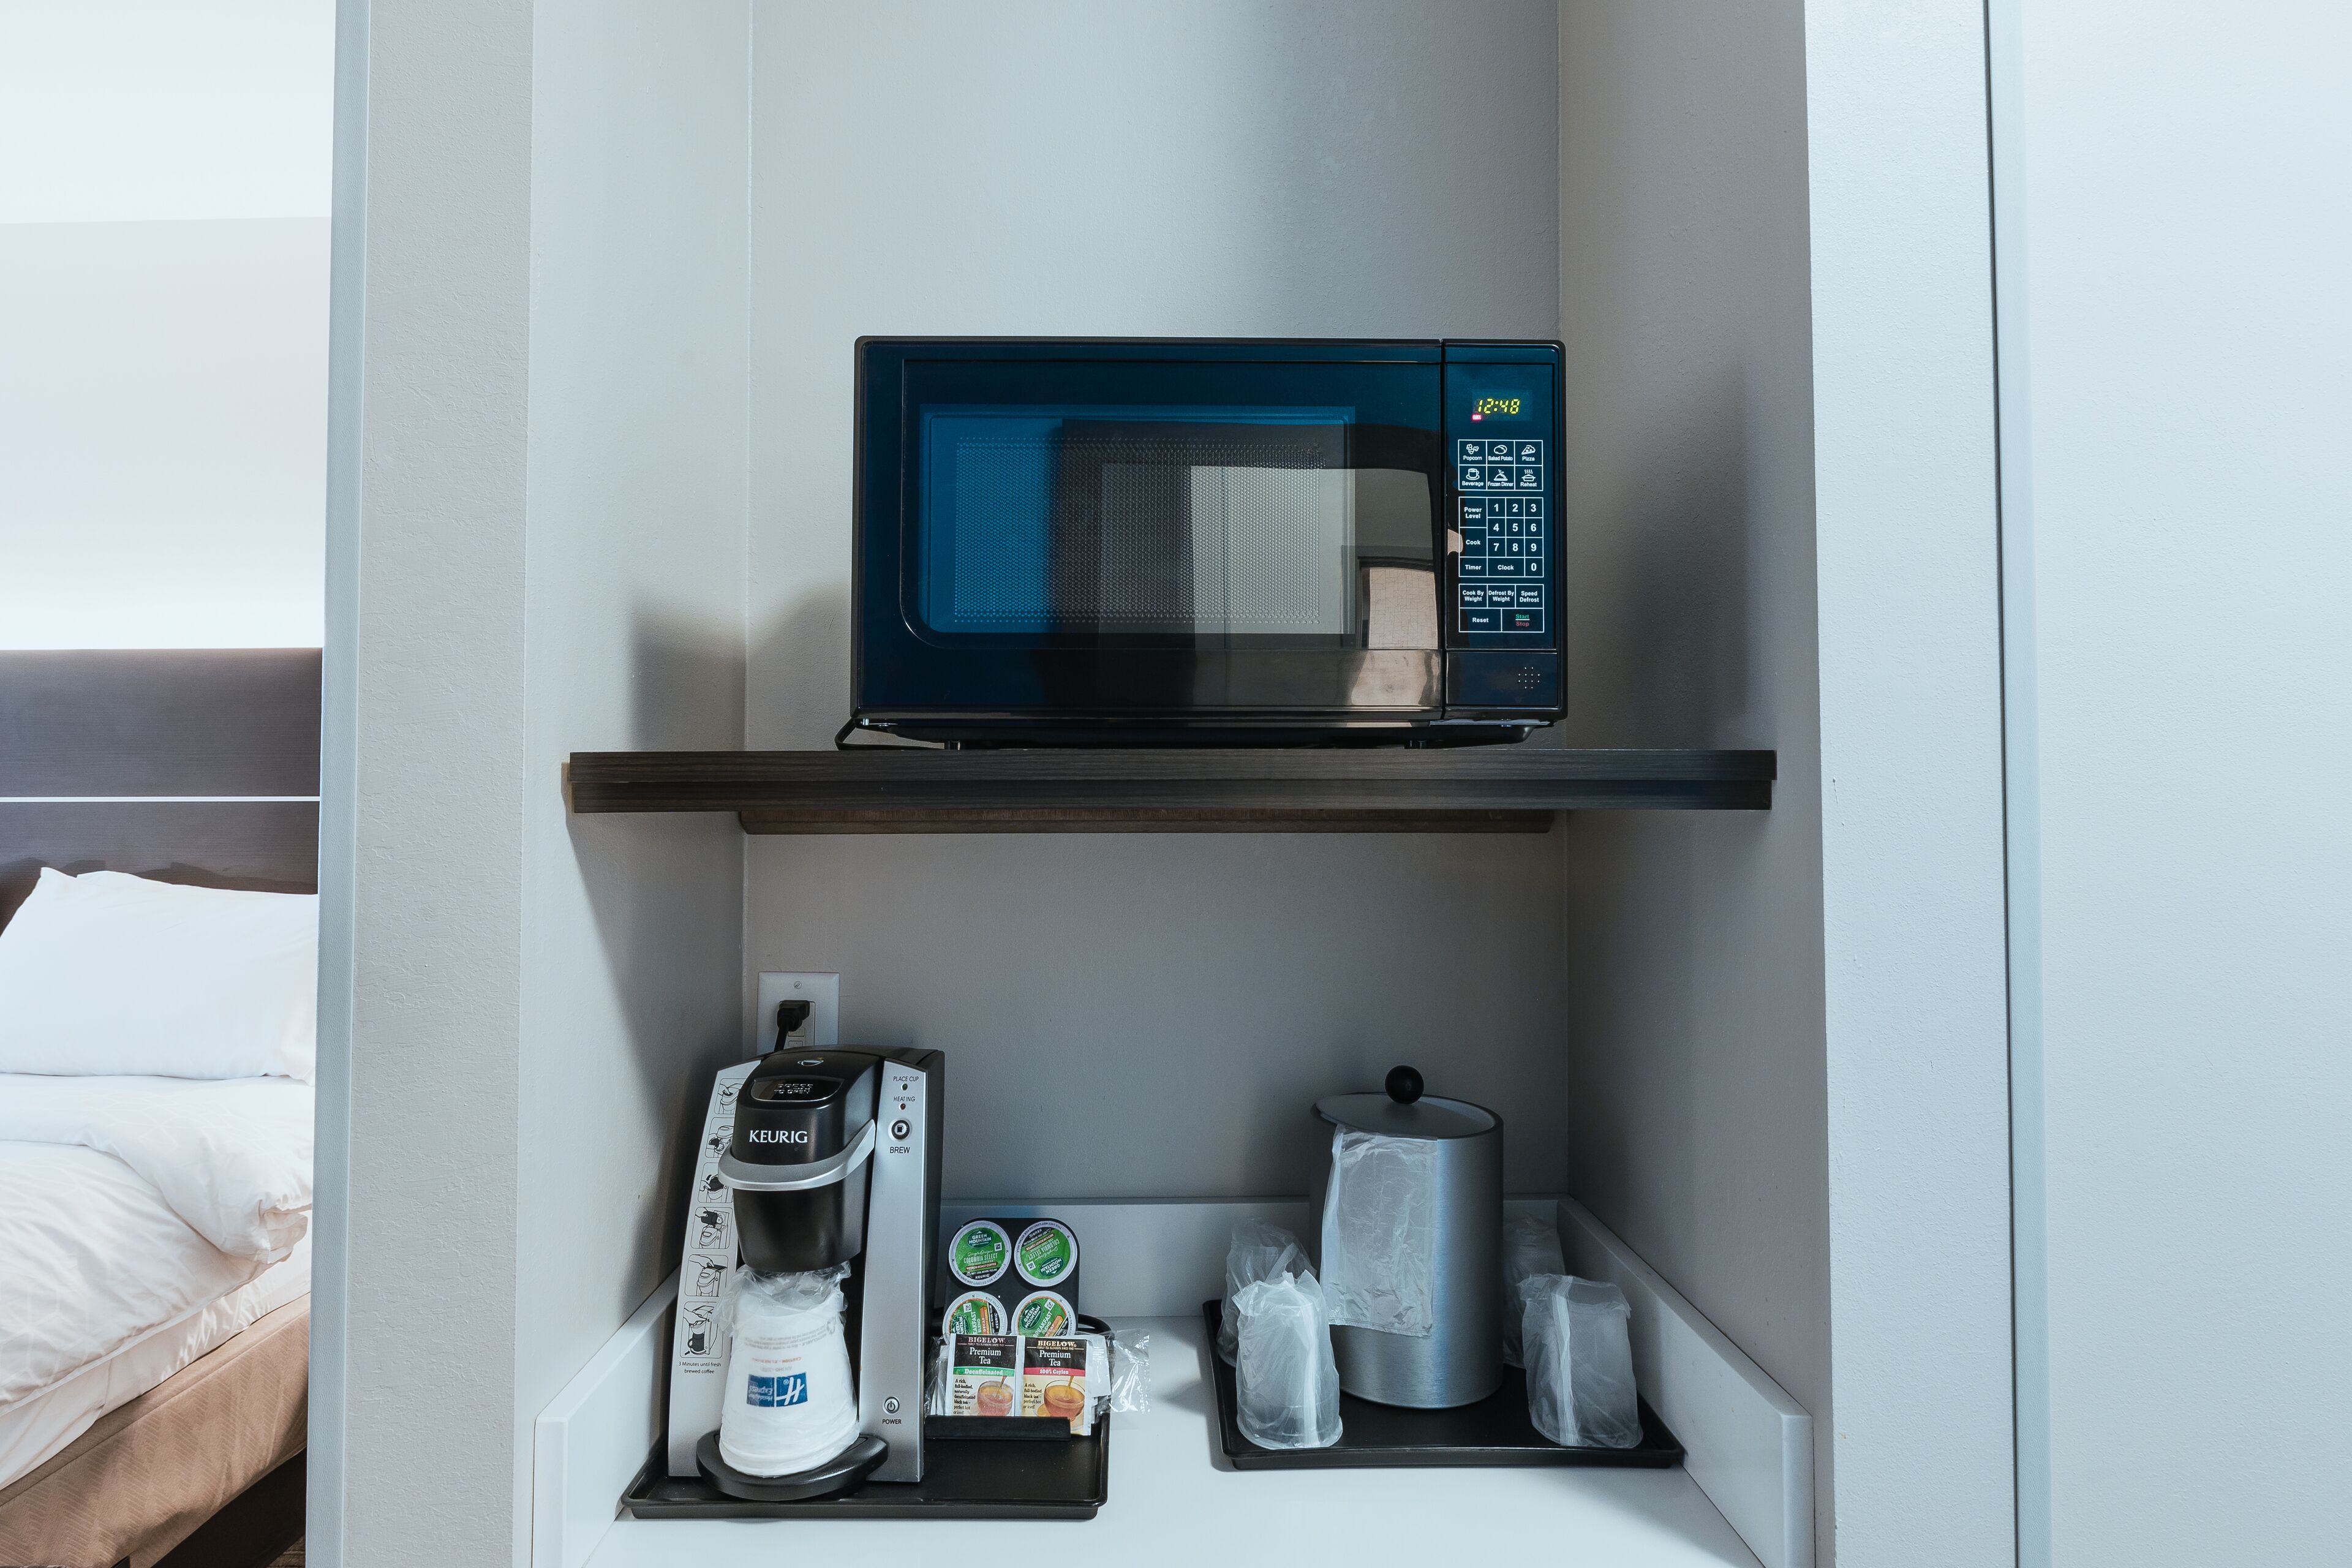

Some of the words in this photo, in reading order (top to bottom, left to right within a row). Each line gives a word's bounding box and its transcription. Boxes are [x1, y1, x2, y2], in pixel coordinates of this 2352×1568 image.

[1478, 398, 1520, 414] 12:48
[1494, 503, 1499, 512] 1
[1512, 503, 1518, 512] 2
[1531, 503, 1536, 512] 3
[1531, 563, 1537, 571] 0
[749, 1130, 808, 1144] KEURIG
[1042, 1238, 1060, 1253] COLOMBIA
[963, 1255, 984, 1264] COLOMBIA
[1040, 1258, 1062, 1272] MOUNTAIN
[1045, 1264, 1060, 1274] GREEN
[1023, 1306, 1035, 1322] GREEN
[1025, 1305, 1041, 1329] MOUNTAIN
[1033, 1311, 1052, 1338] BREAKFAST
[970, 1347, 1001, 1356] Premium
[1039, 1350, 1071, 1359] Premium
[979, 1356, 990, 1365] Tea
[749, 1385, 773, 1395] Express
